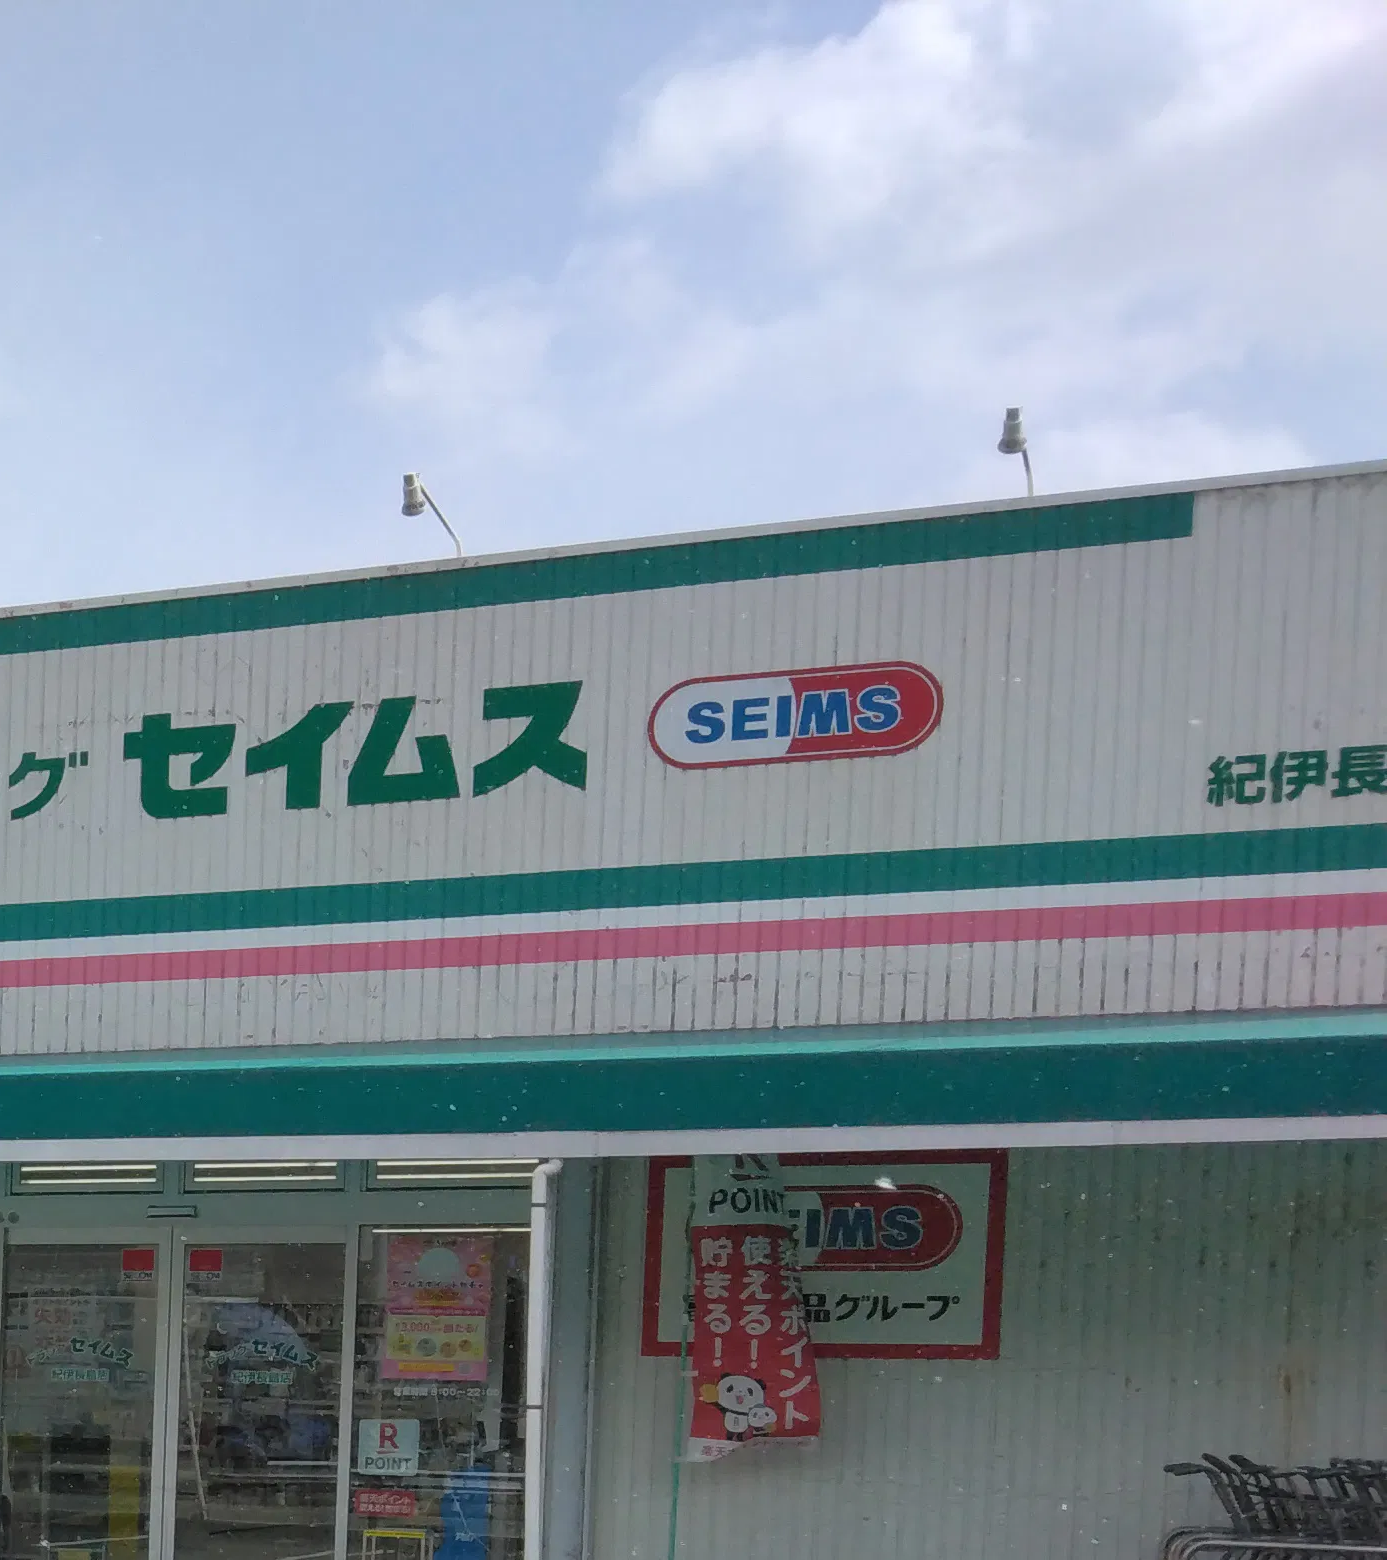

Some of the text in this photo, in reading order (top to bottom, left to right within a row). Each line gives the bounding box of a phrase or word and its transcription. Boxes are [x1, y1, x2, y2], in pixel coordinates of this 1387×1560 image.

[685, 685, 901, 744] SEIMS
[124, 680, 587, 819] セイムス
[1207, 744, 1387, 807] 紀伊長
[787, 1206, 922, 1249] IMS
[700, 1237, 733, 1367] 貯まる！
[739, 1236, 773, 1369] 使える！
[365, 1457, 412, 1470] POINT
[379, 1423, 399, 1449] R
